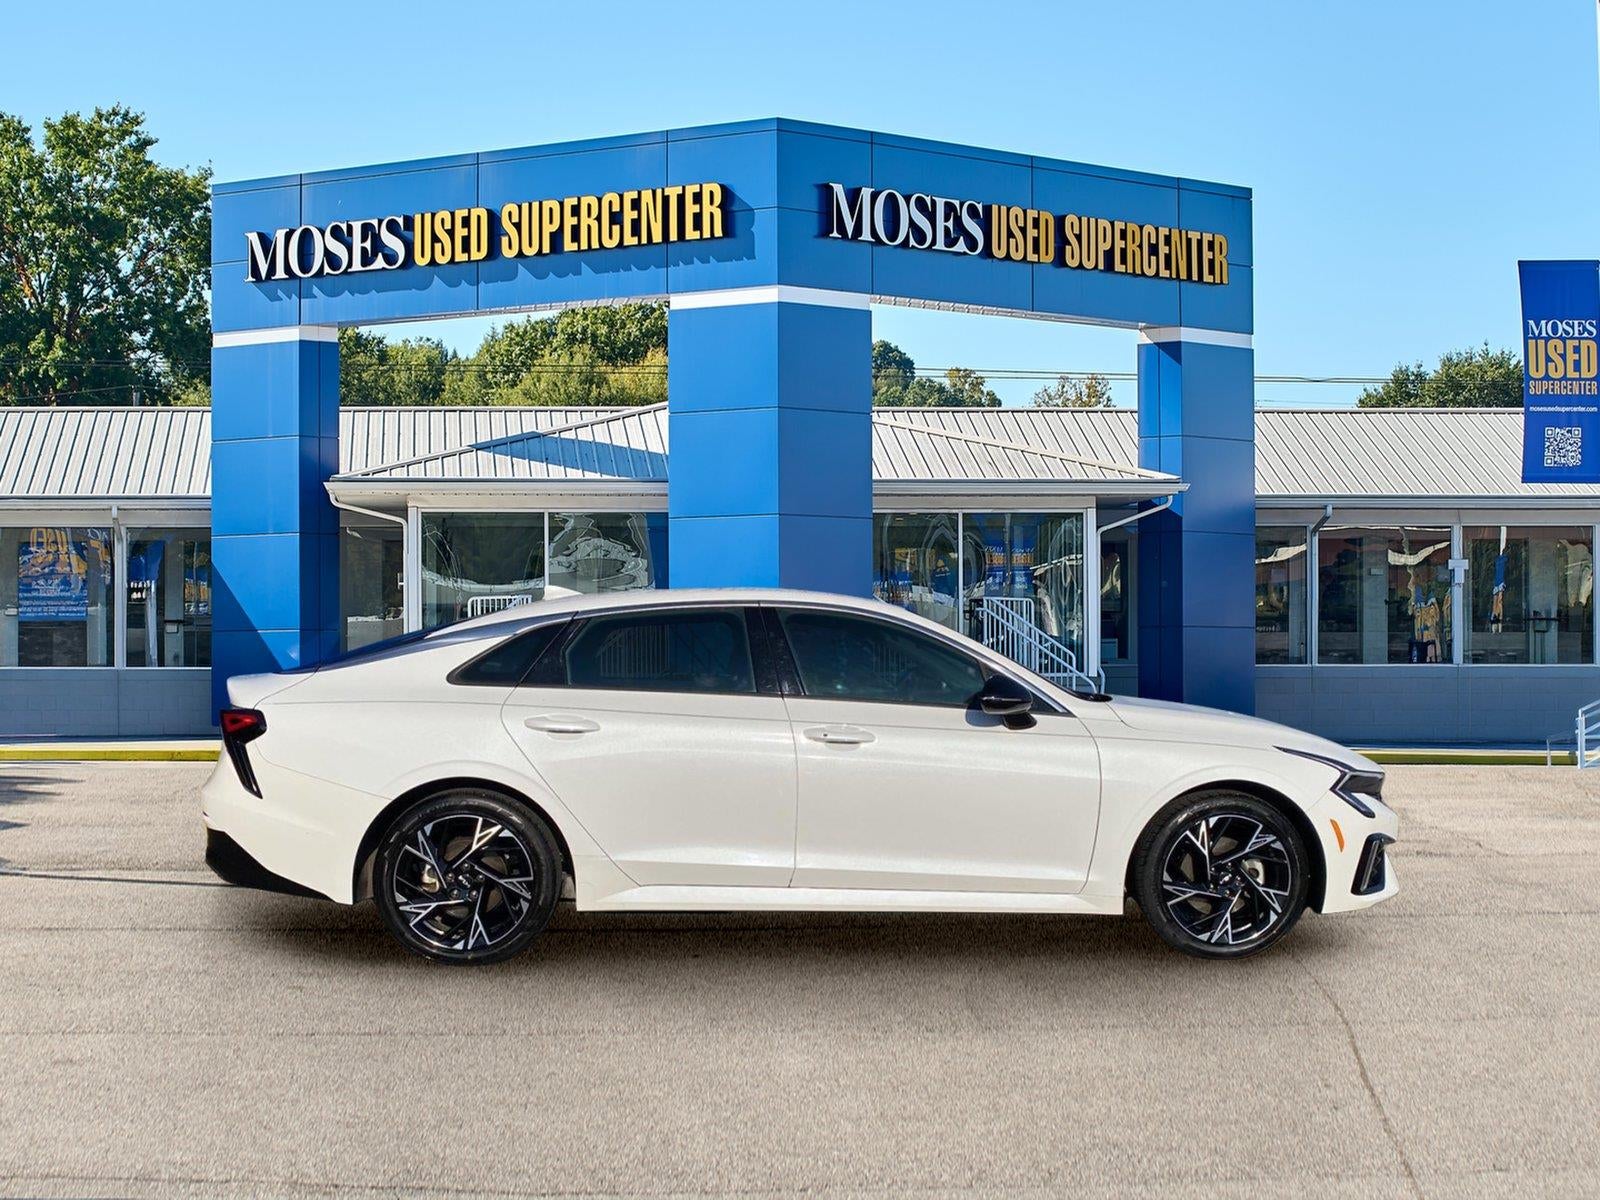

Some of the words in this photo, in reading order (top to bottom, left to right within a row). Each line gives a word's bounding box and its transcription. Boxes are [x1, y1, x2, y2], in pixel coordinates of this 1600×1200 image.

[245, 215, 406, 282] MOSES
[413, 207, 490, 265] USED
[500, 182, 723, 258] SUPERCENTER
[829, 182, 985, 255] MOSES
[991, 204, 1055, 264] USED
[1064, 213, 1229, 285] SUPERCENTER
[1527, 319, 1598, 338] MOSES
[1527, 339, 1598, 379] USED
[1529, 380, 1598, 396] SUPERCENTER
[1529, 405, 1598, 413] mosesusedsupercenter.com
